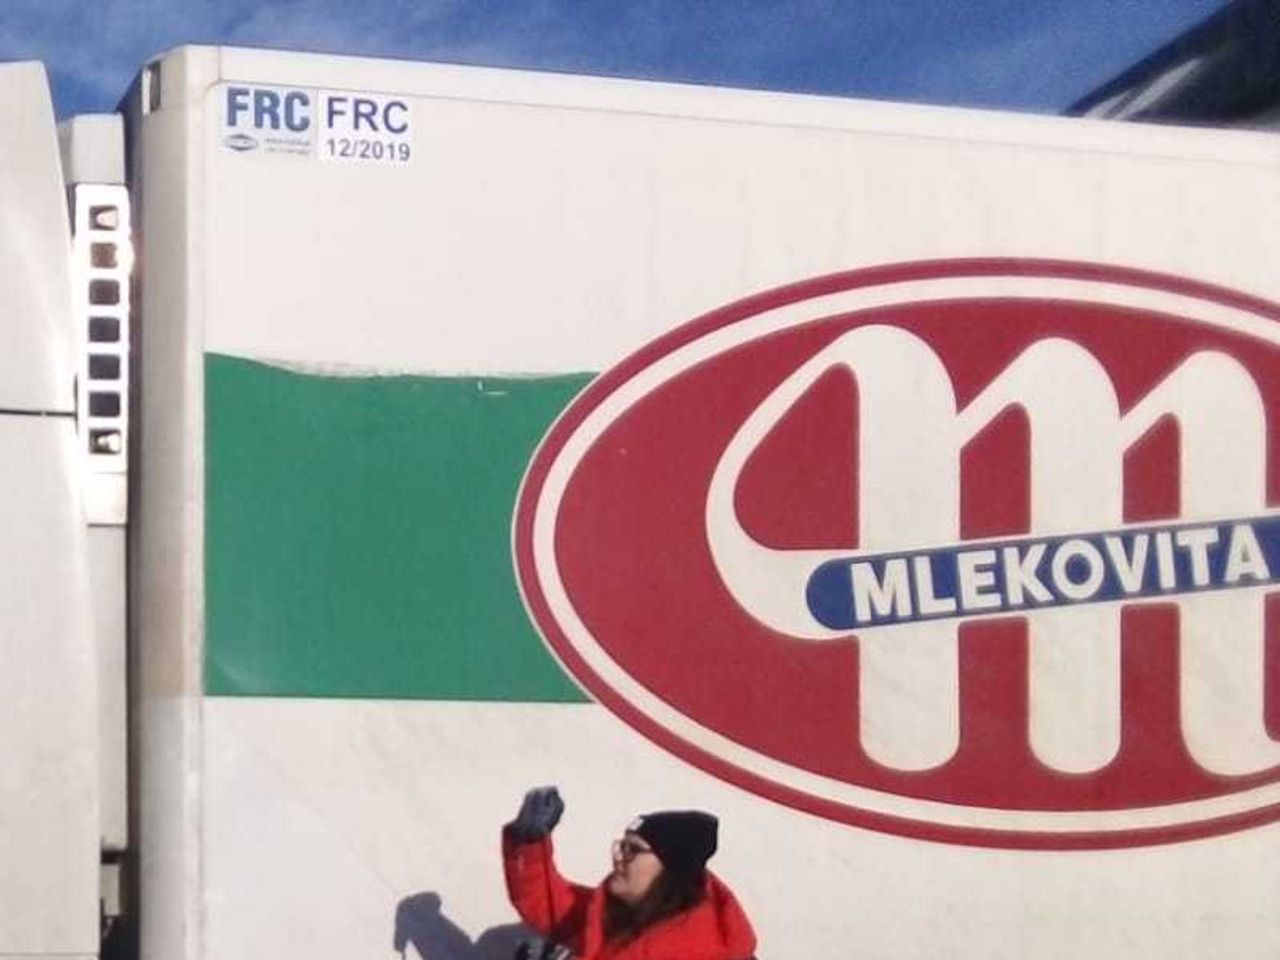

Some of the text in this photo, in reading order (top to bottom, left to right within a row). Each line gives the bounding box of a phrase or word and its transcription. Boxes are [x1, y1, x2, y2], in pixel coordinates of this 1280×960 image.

[227, 87, 310, 132] FRC
[327, 96, 409, 134] FRC
[327, 138, 411, 161] 12/2019
[850, 523, 1271, 623] MLEKOVITA
